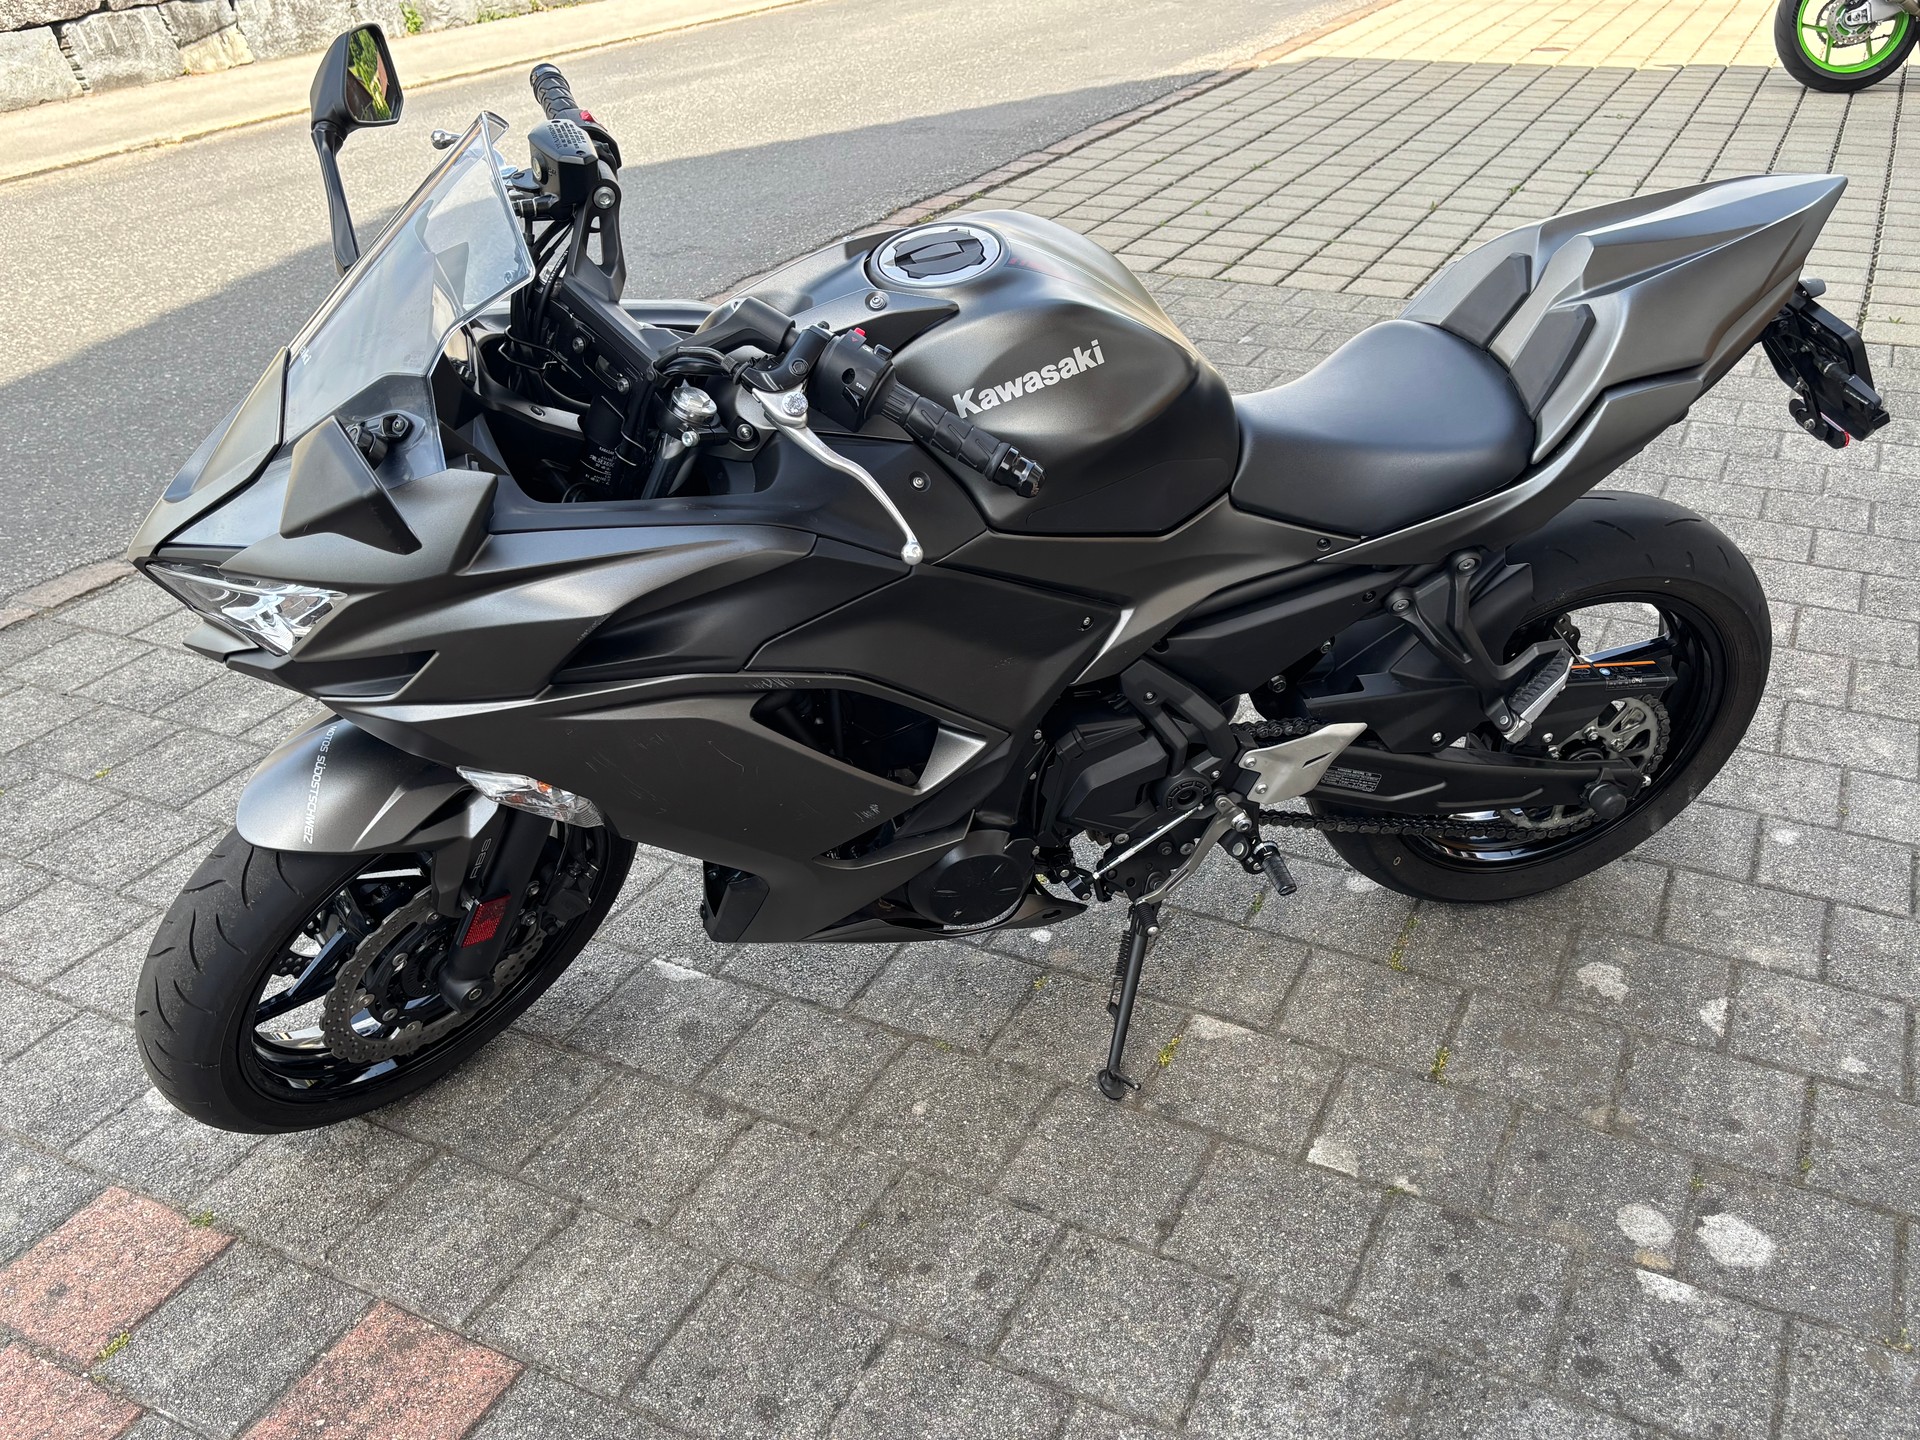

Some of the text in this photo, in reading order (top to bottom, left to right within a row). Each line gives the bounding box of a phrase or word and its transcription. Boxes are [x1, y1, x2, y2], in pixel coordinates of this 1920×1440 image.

[952, 339, 1105, 419] Kawasaki
[303, 725, 338, 844] MOTOS SÜDOSTSCHWEIZ
[469, 838, 492, 879] ABS
